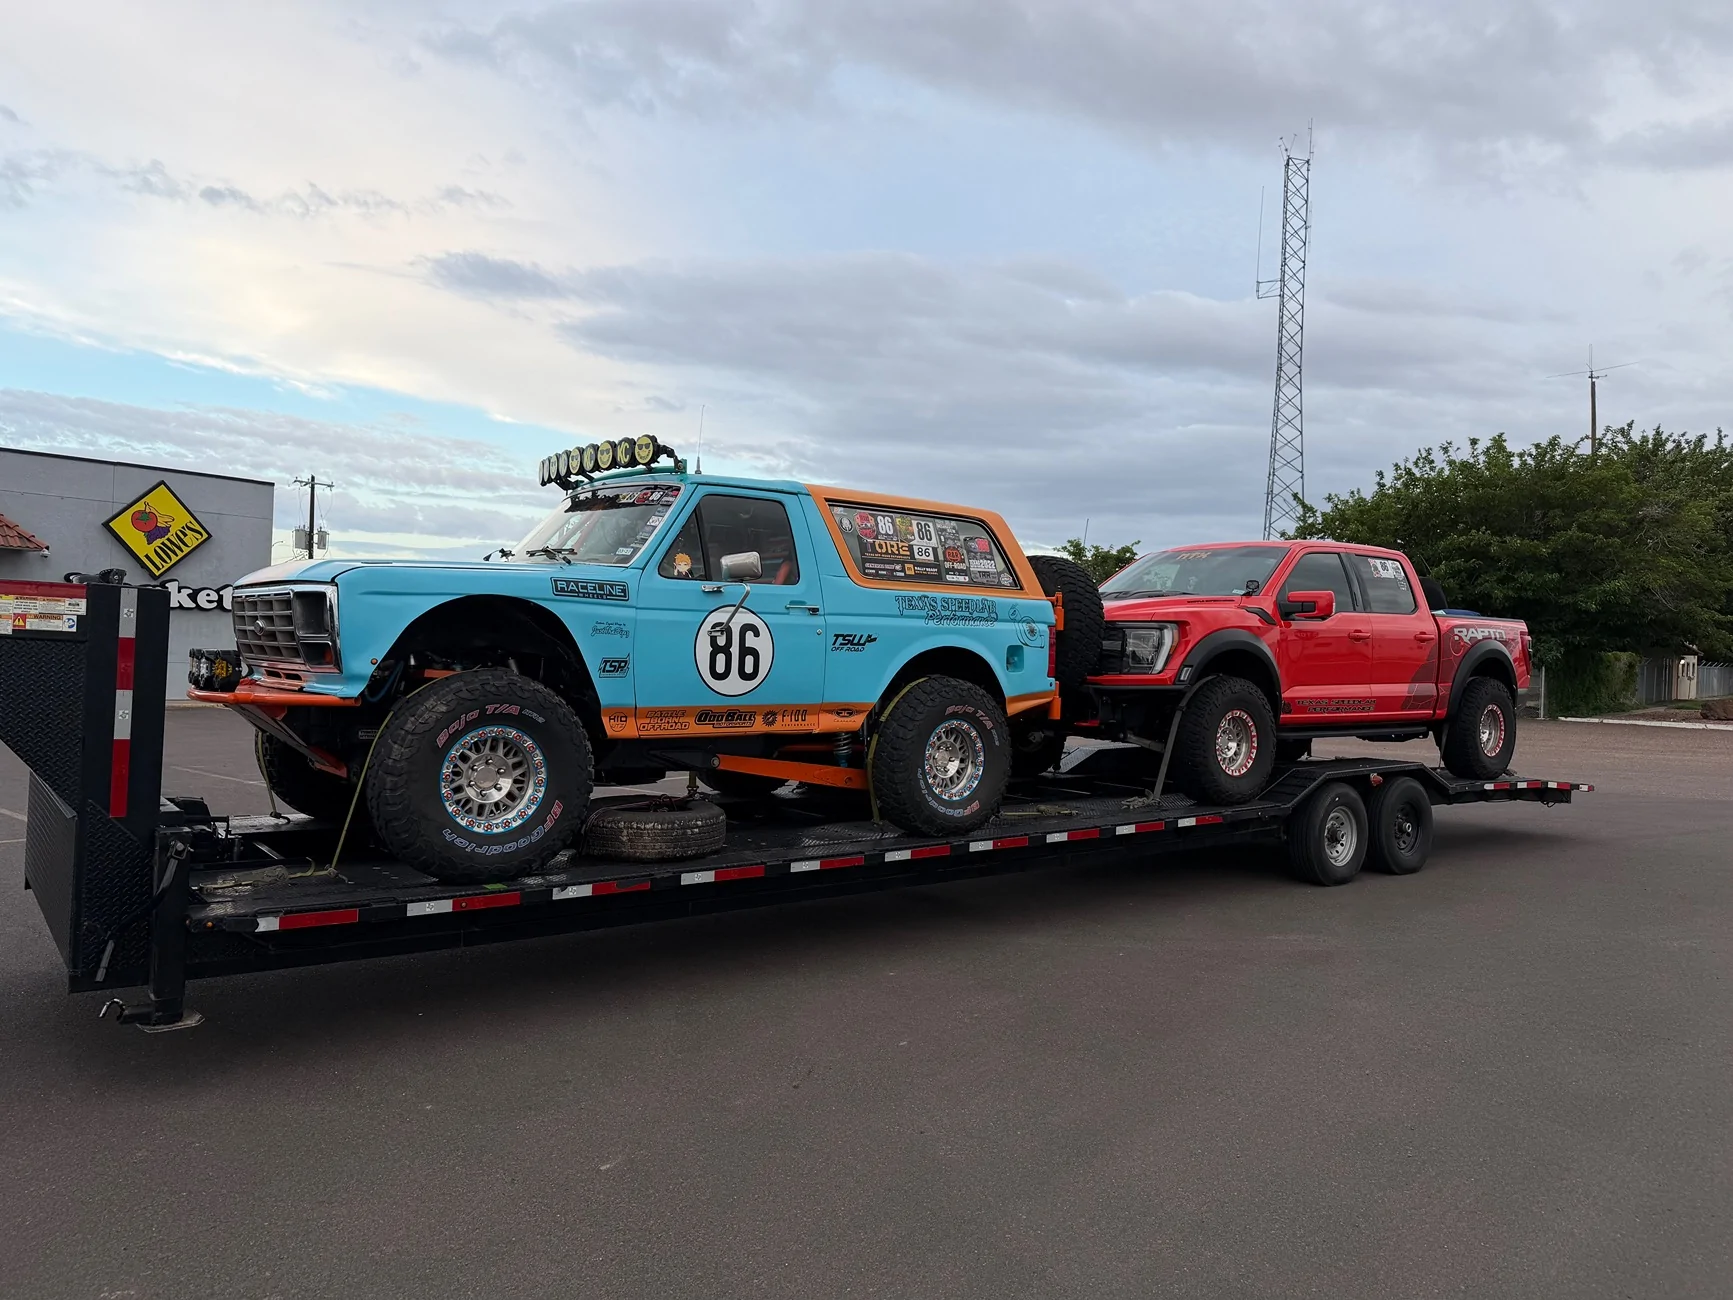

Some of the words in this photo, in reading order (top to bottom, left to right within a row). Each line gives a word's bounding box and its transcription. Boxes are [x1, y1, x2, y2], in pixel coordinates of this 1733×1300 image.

[617, 441, 630, 464] KC
[876, 515, 894, 535] 86
[915, 521, 933, 542] 86
[917, 547, 931, 557] 86
[163, 581, 233, 610] ket
[556, 580, 625, 596] RACELINE
[895, 595, 938, 616] TEXAS
[941, 597, 998, 615] SPEEDLAB
[924, 609, 999, 627] Performance
[1453, 627, 1506, 645] RAPTO
[709, 621, 761, 681] 86
[601, 659, 629, 674] TSP
[436, 709, 480, 748] Baja
[485, 703, 521, 716] T/A
[639, 722, 690, 732] OFFROAD
[975, 709, 994, 730] T/A
[442, 799, 564, 856] BFGoodrich
